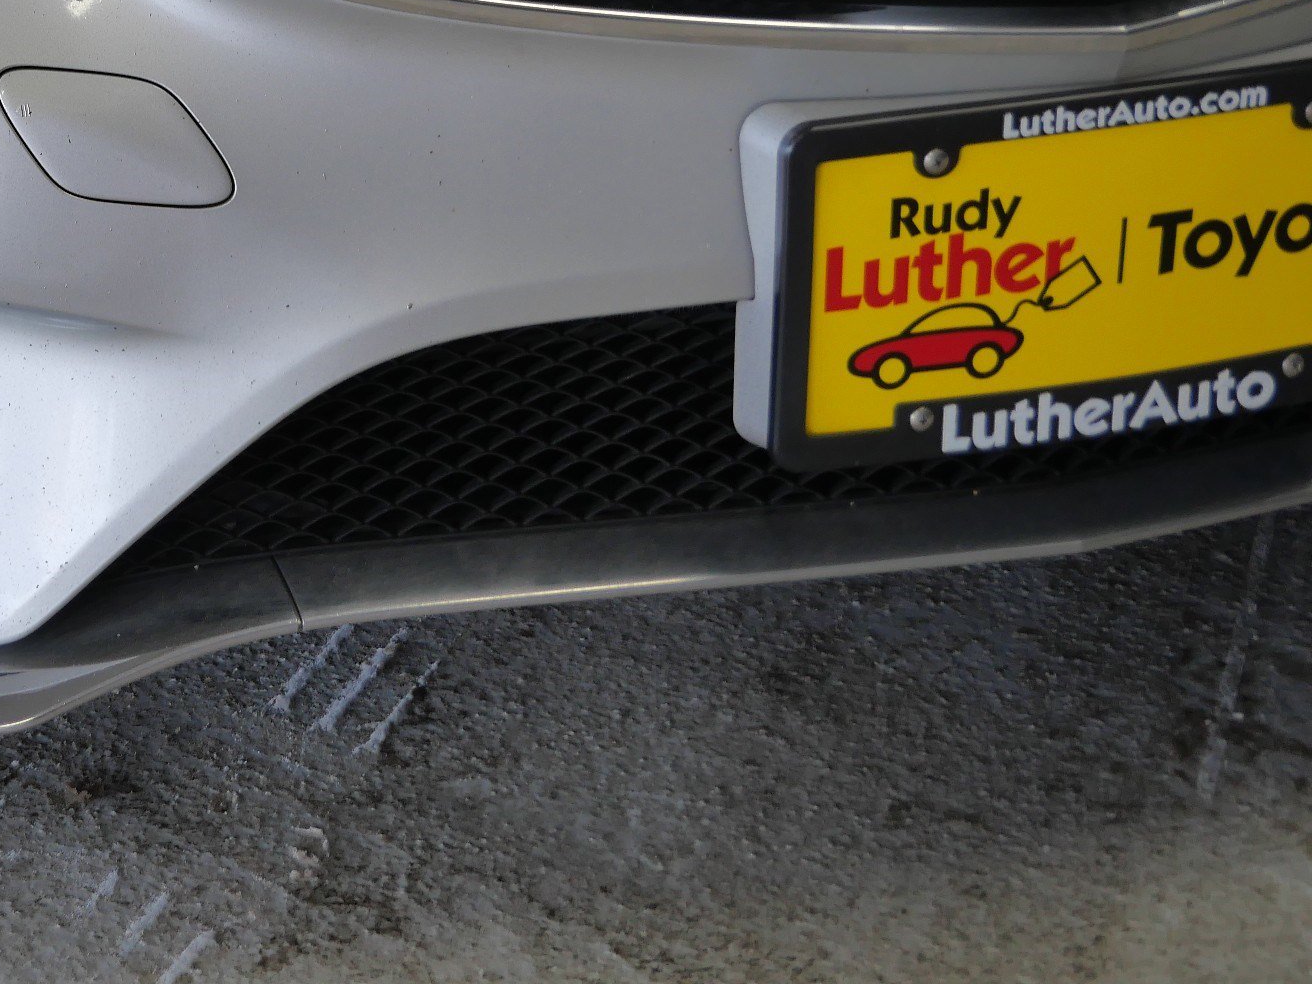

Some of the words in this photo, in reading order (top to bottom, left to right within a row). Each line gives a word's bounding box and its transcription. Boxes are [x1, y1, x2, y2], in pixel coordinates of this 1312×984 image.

[1002, 86, 1268, 140] LutherAuto.com
[890, 189, 1022, 238] Rudy
[1147, 203, 1312, 277] Toyo
[824, 234, 1076, 312] Luther
[941, 368, 1276, 453] LutherAuto
